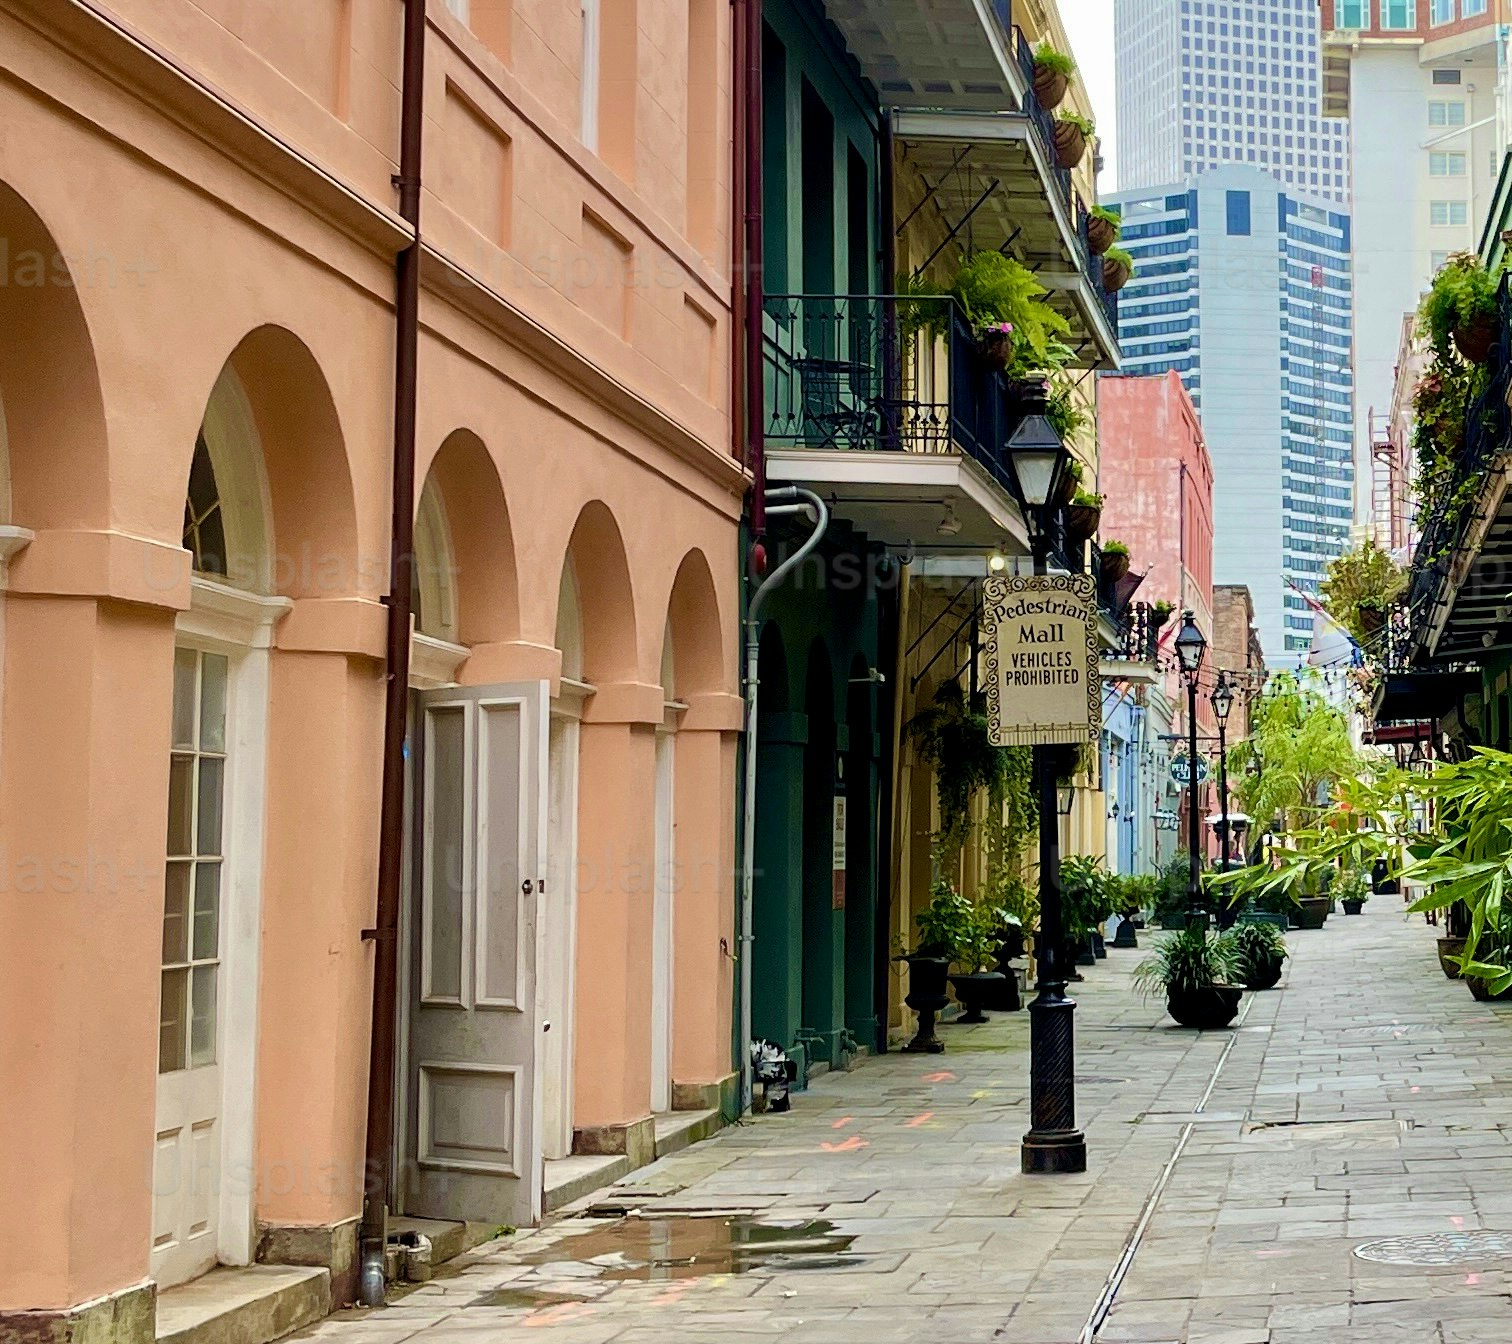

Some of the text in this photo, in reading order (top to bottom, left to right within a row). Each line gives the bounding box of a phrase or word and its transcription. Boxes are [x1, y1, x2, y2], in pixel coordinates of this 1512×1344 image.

[993, 598, 1088, 623] Pedestrian
[1018, 623, 1065, 644] Mall
[1012, 651, 1072, 669] VEHICLES
[1006, 669, 1079, 687] PROHIBITED
